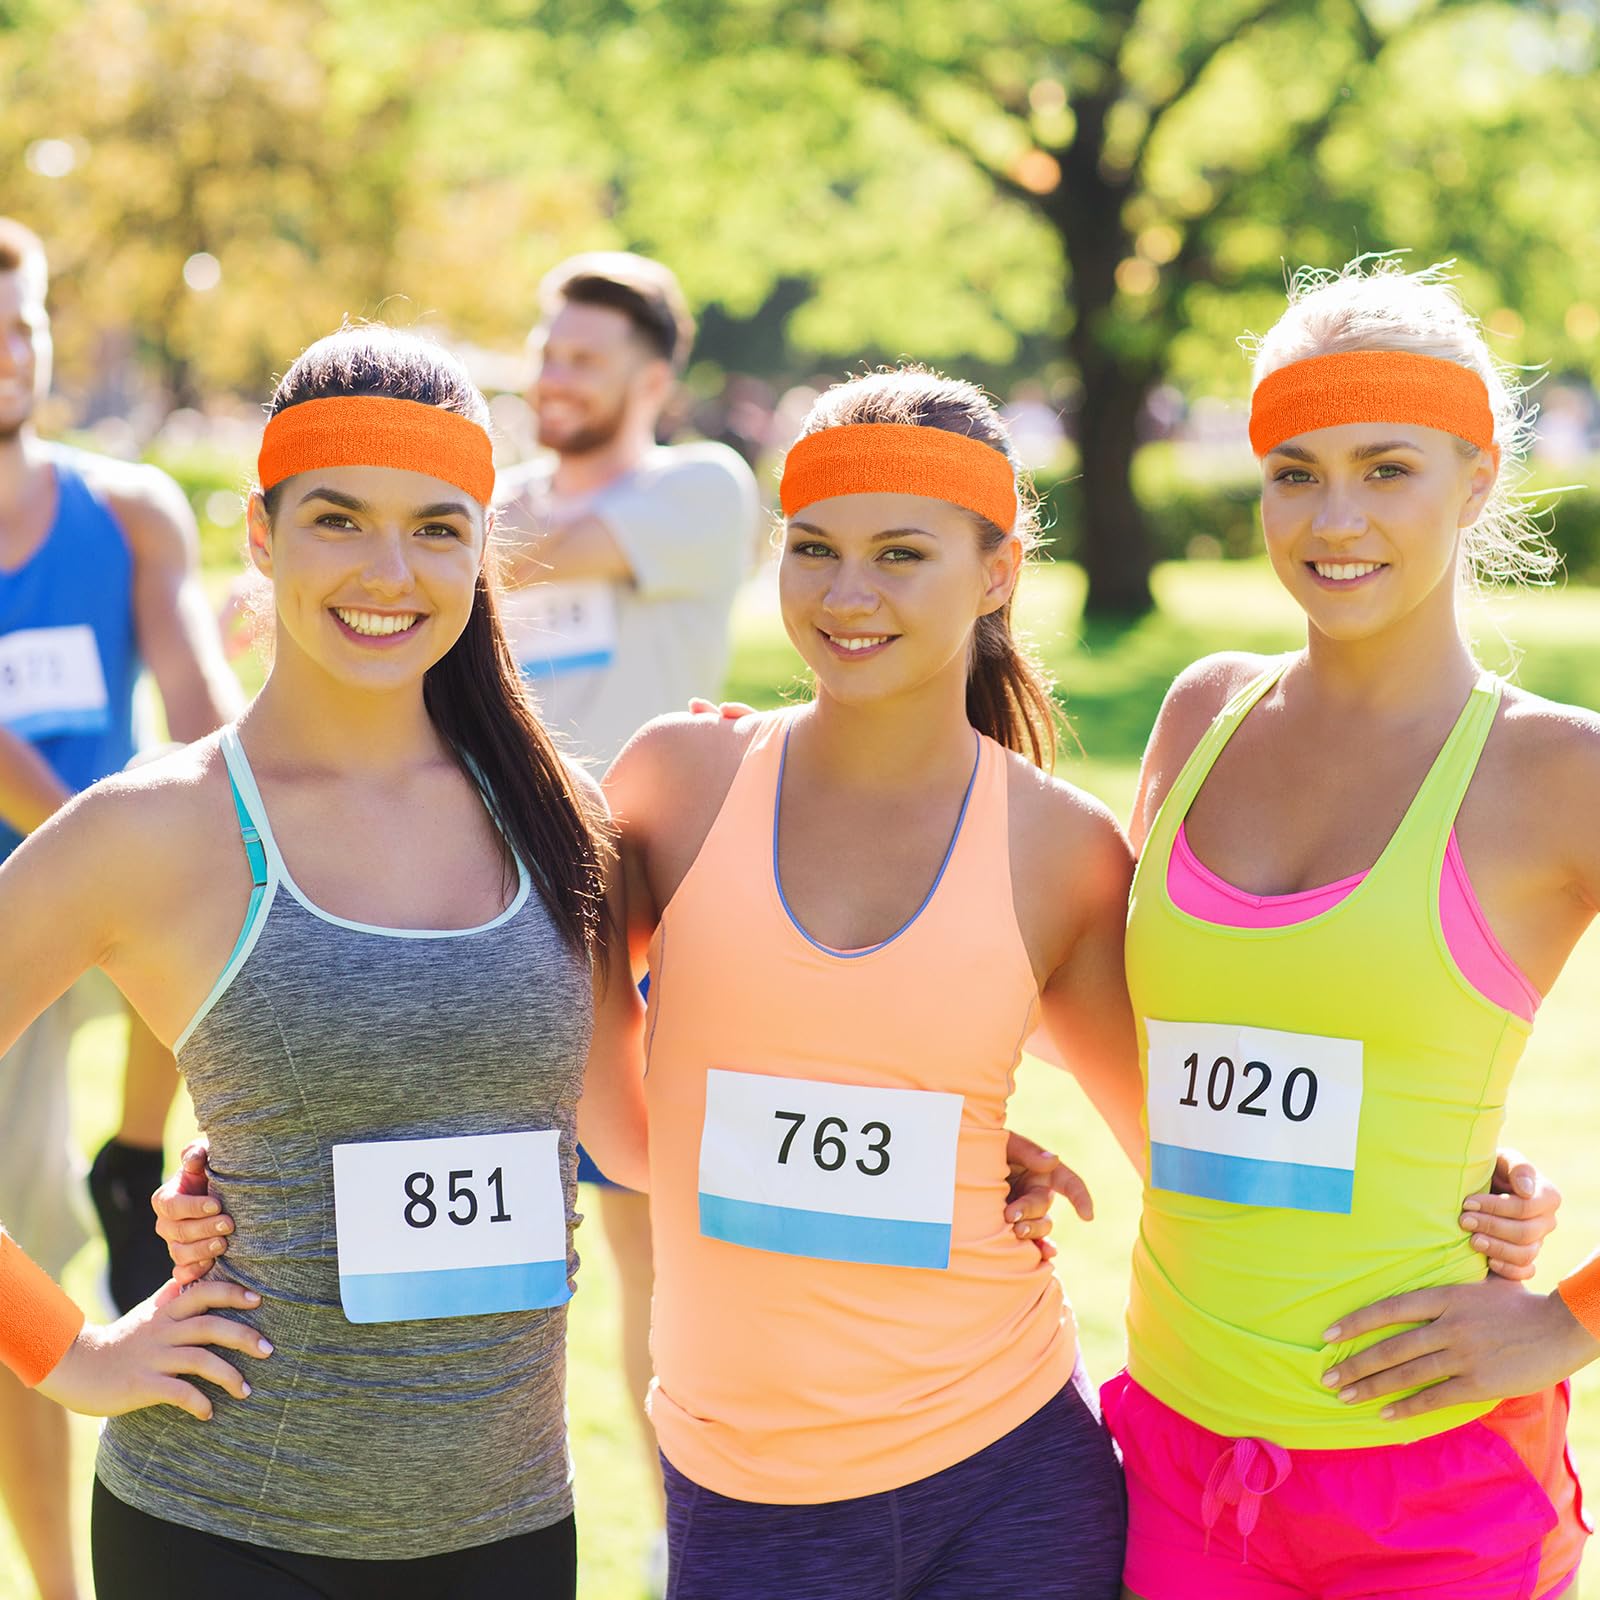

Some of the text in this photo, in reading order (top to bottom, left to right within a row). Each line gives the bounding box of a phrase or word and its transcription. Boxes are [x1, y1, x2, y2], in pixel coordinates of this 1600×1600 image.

[1179, 1052, 1318, 1123] 1020
[774, 1110, 892, 1176] 763
[403, 1167, 512, 1229] 851
